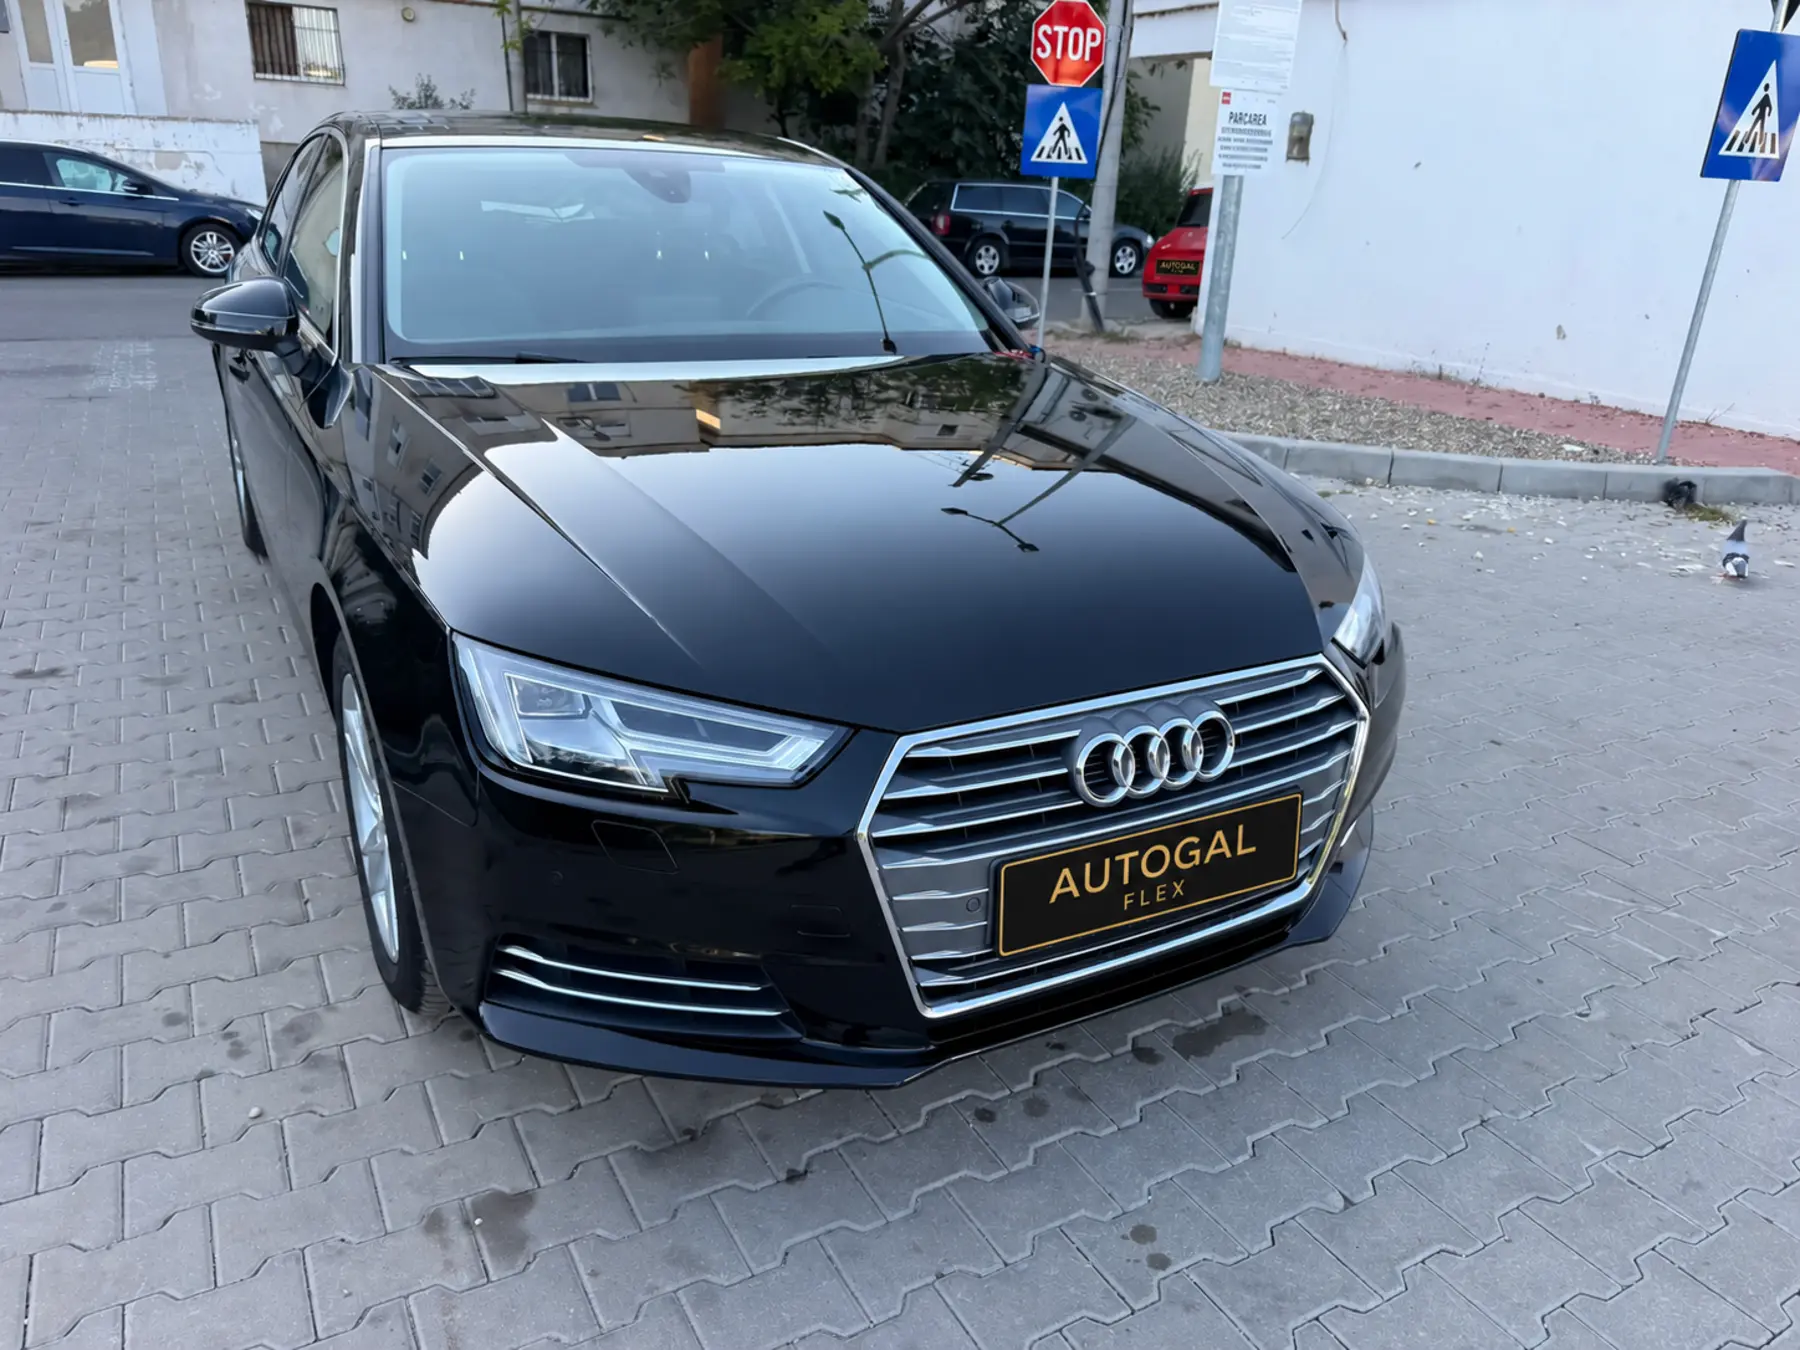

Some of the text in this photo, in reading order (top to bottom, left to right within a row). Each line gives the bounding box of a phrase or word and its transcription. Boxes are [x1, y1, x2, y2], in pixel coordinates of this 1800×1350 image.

[1036, 24, 1101, 62] STOP
[1228, 111, 1267, 126] PARCAREA
[1049, 824, 1257, 904] AUTOGAL
[1124, 879, 1185, 911] FLEX
